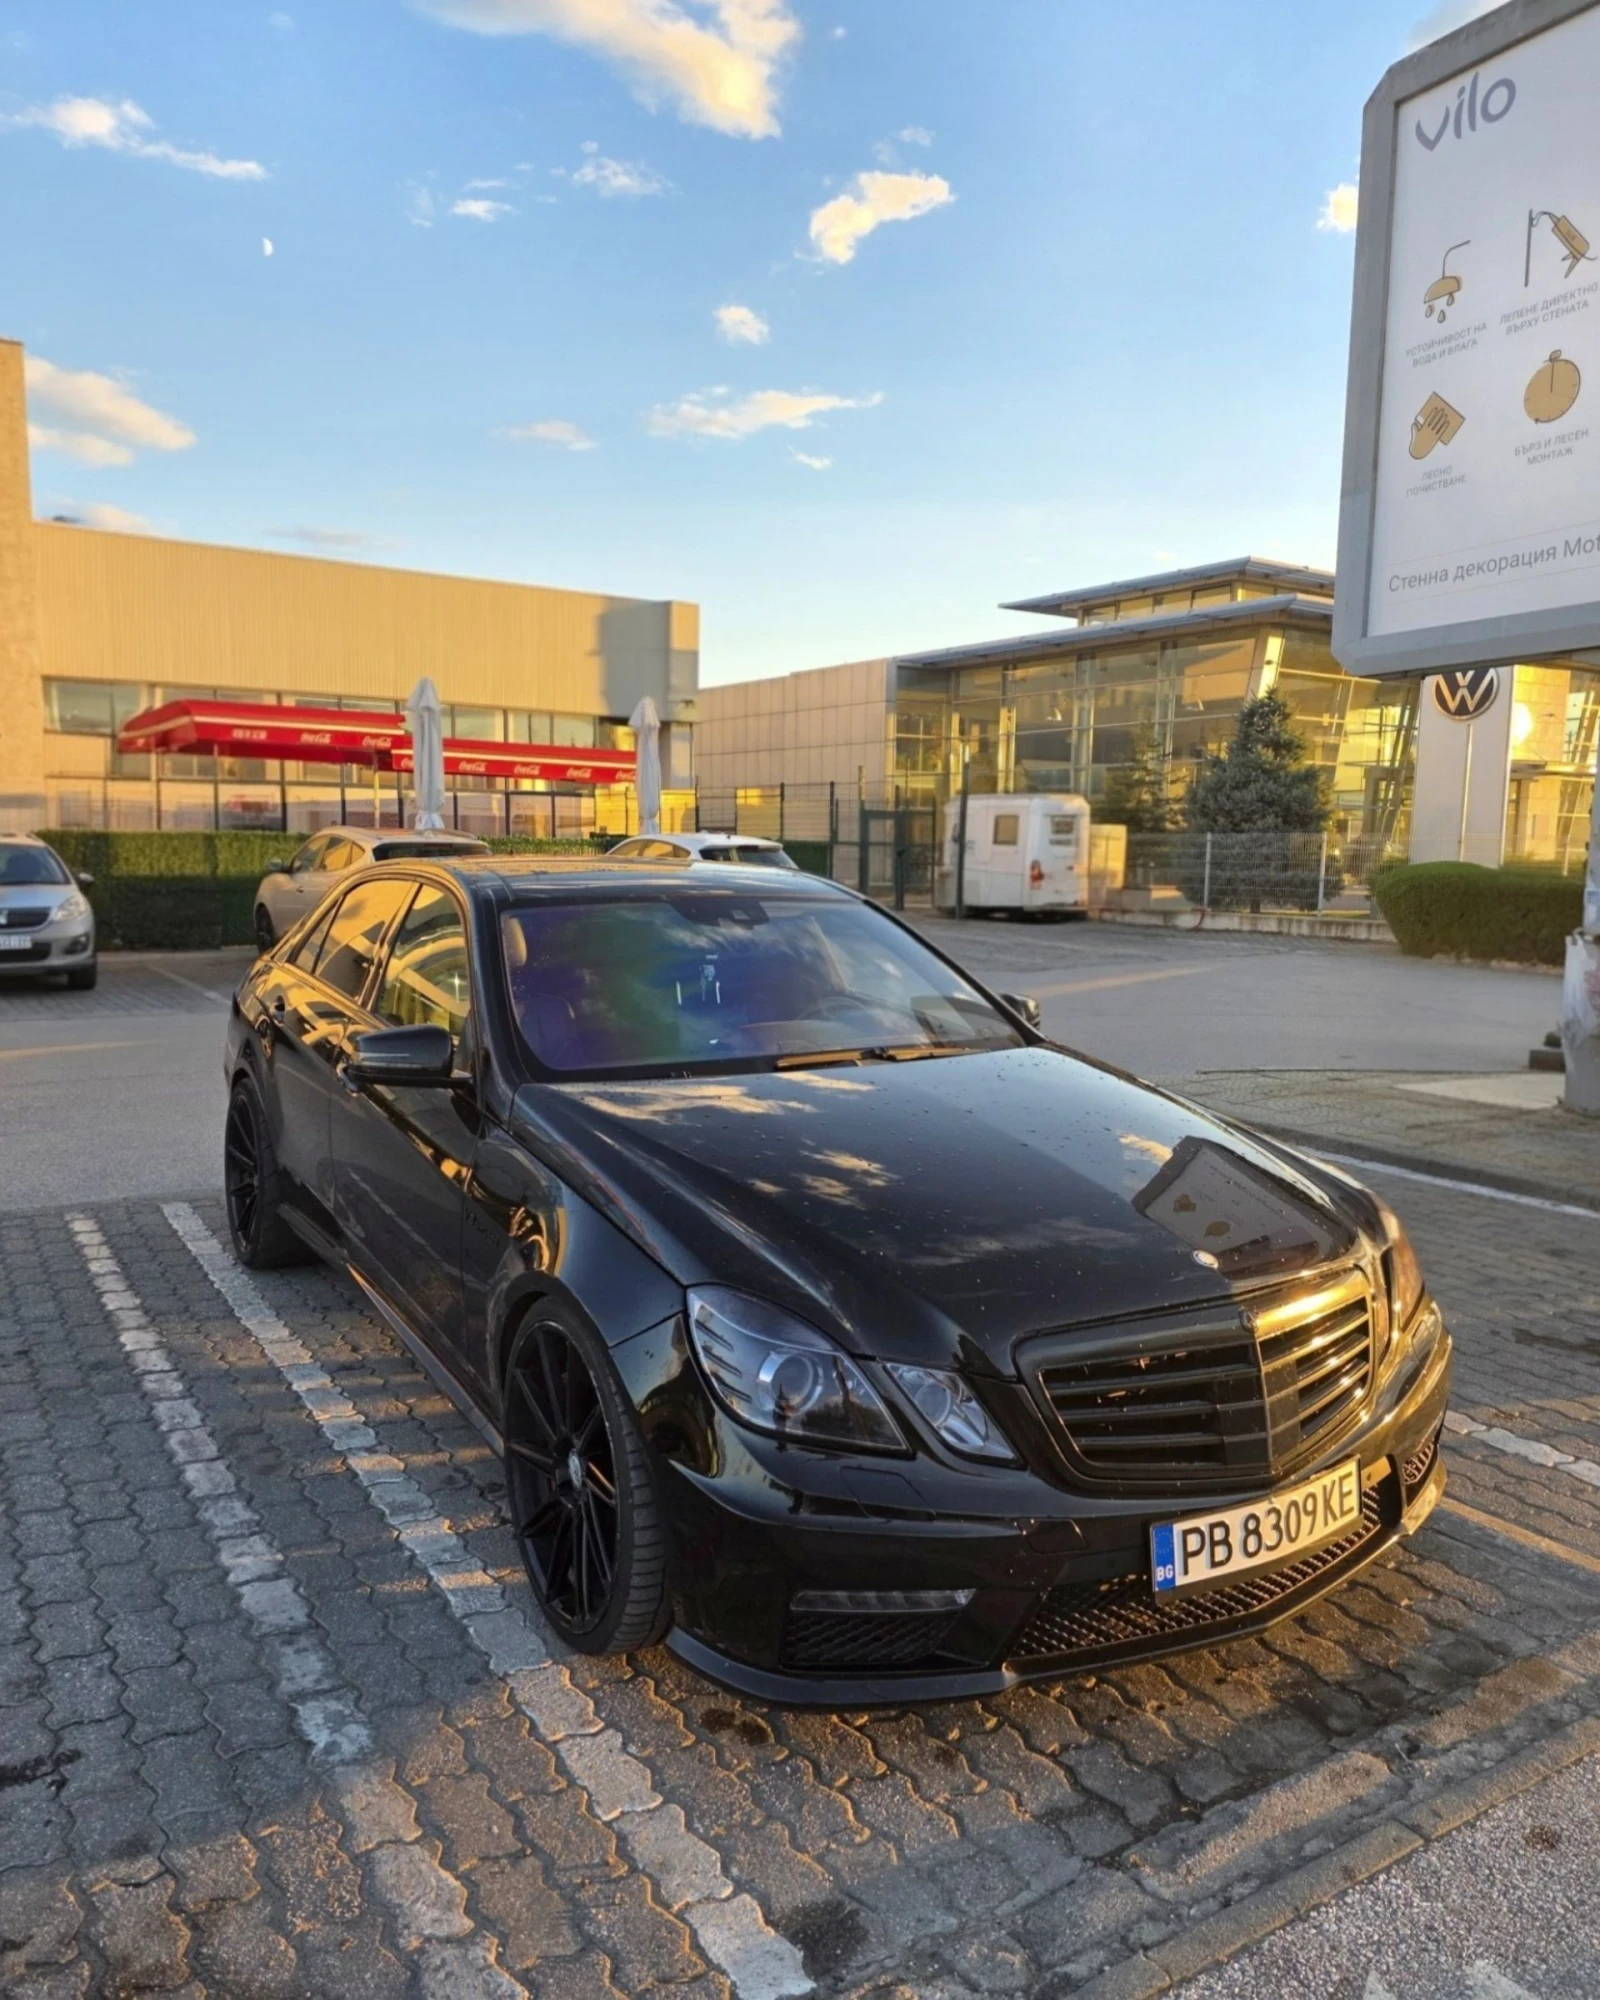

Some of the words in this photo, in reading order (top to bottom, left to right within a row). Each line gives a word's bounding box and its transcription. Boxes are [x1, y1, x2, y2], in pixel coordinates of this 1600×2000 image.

[1415, 71, 1516, 151] vilo
[1500, 306, 1539, 325] ЛЕПЕНЕ
[1540, 281, 1599, 312] ДИРЕКТНО
[1505, 315, 1540, 336] ВЪРХУ
[1542, 299, 1590, 322] СТЕНАТА
[1405, 327, 1472, 357] УСТОЙЧИВОСТ
[1473, 321, 1488, 335] НА
[1412, 353, 1437, 368] ВОДА
[1438, 349, 1446, 358] И
[1447, 337, 1479, 356] ВЛАГА
[1514, 441, 1542, 457] БЪРЗ
[1544, 438, 1551, 448] И
[1553, 427, 1590, 446] ЛЕСЕН
[1526, 446, 1575, 466] МОНТАЖ
[1406, 473, 1468, 498] ПОЧИСТВАНЕ
[1421, 465, 1453, 482] ЛЕСНО
[1388, 568, 1449, 593] Стенна
[1453, 546, 1557, 583] декорация
[1181, 1520, 1232, 1576] PB
[1242, 1492, 1317, 1557] 8309
[1322, 1471, 1354, 1528] KE
[1157, 1564, 1174, 1581] BG
